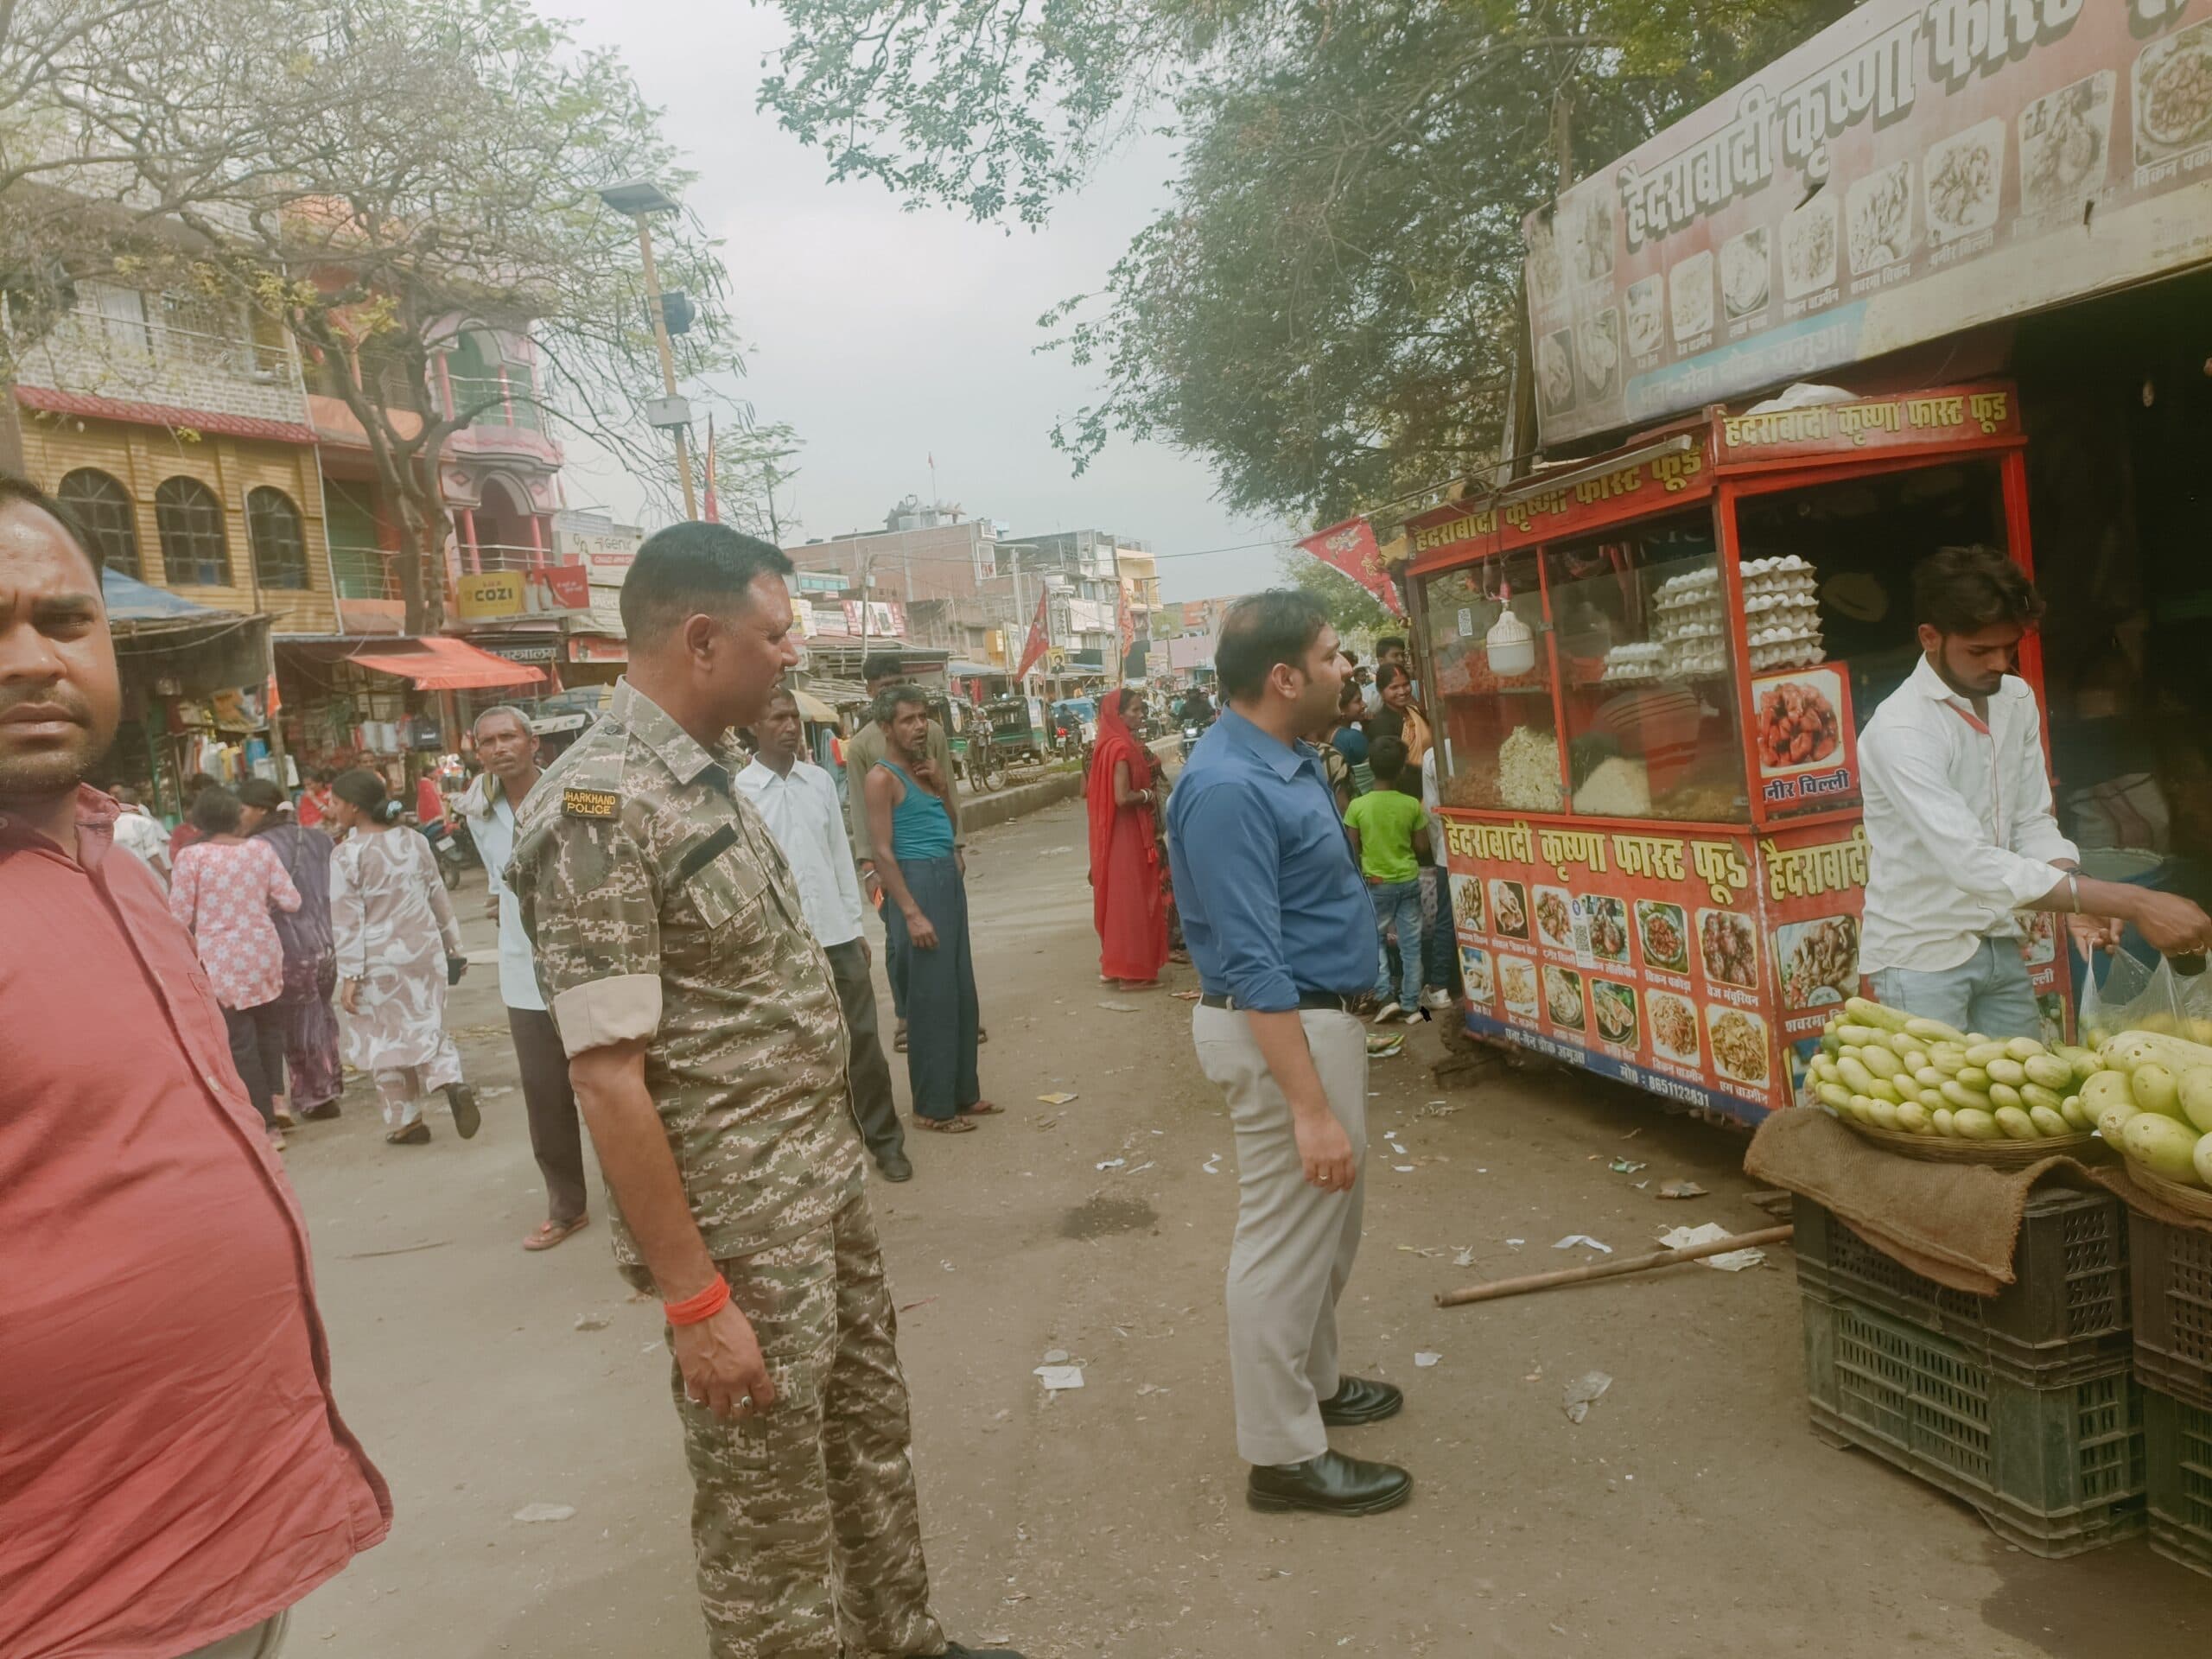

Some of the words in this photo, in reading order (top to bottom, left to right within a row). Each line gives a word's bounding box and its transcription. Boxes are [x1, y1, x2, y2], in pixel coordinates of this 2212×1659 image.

[1617, 84, 1776, 254] हैदराबादी
[1777, 10, 1920, 192] कृष्णा
[1837, 402, 1901, 446] कृष्णा
[1907, 397, 1964, 429] फास्ट
[1968, 392, 2007, 434] फूड
[474, 588, 513, 603] COZI
[563, 791, 616, 805] JHARKHAND
[1798, 768, 1850, 798] चिल्ली
[567, 803, 612, 815] POLICE
[1440, 814, 1535, 864] हैदराबादी
[1538, 830, 1607, 881] कृष्णा
[1612, 834, 1686, 881] फास्ट
[1690, 839, 1749, 906] फूड
[1759, 824, 1872, 900] हैदराबादी
[1784, 1014, 1826, 1033] शवरमा
